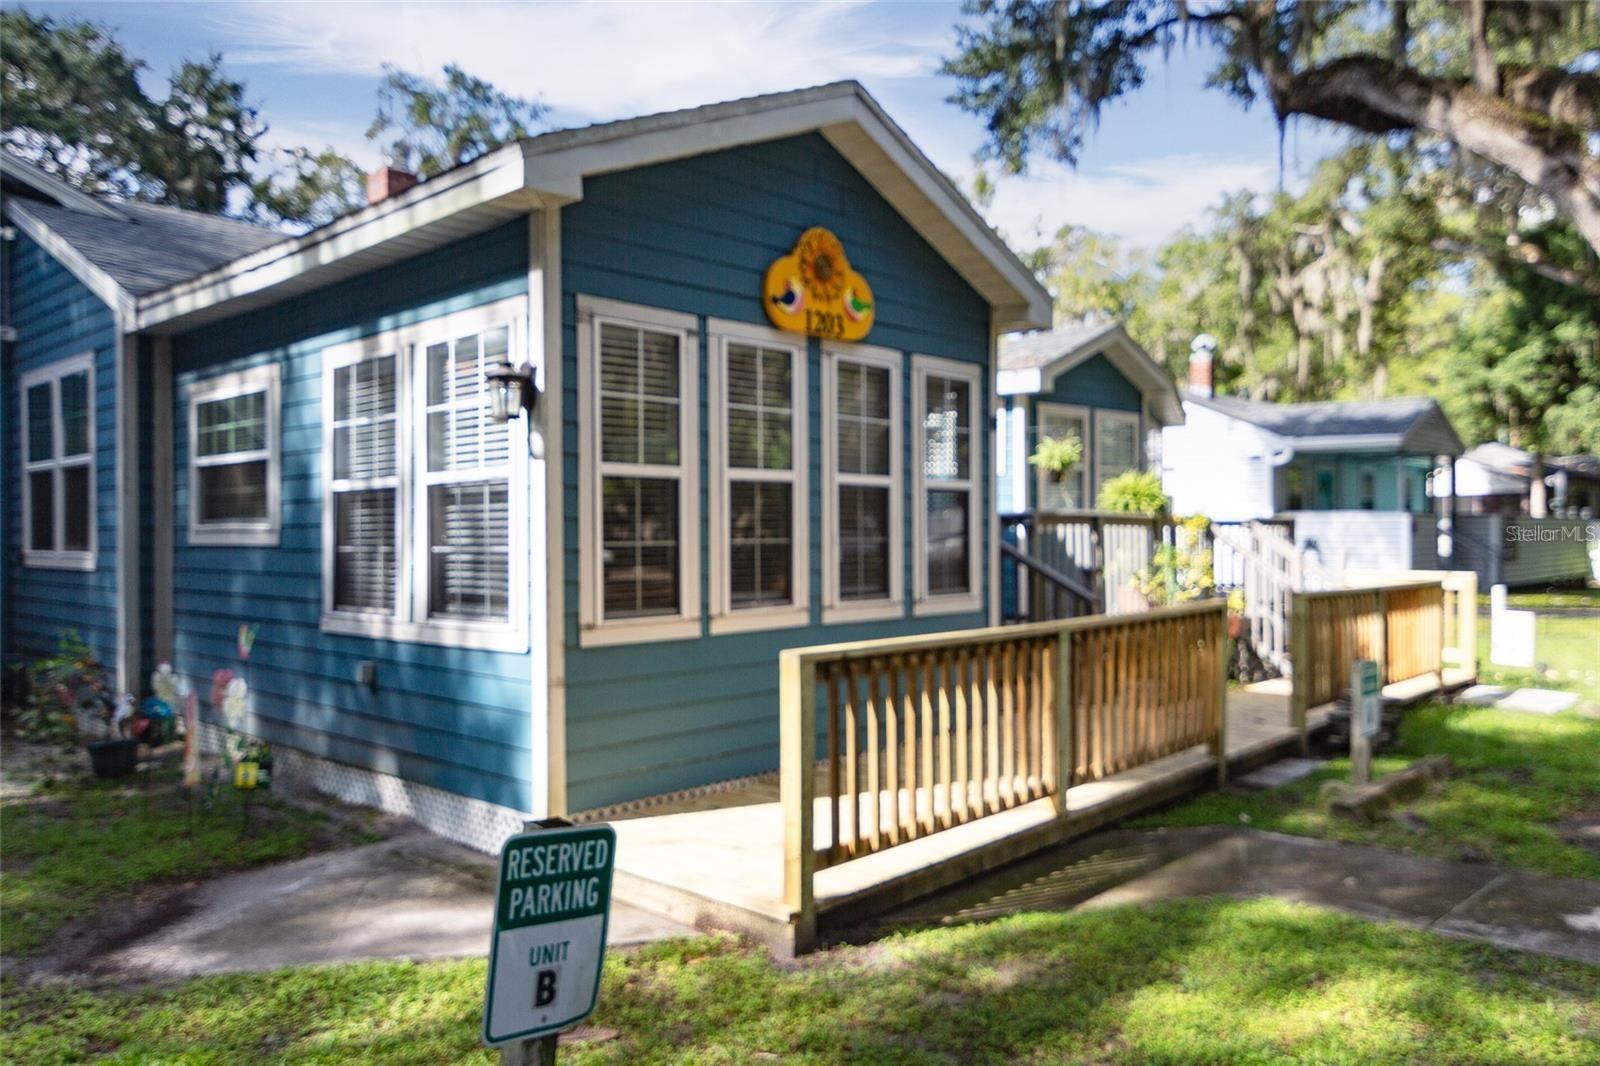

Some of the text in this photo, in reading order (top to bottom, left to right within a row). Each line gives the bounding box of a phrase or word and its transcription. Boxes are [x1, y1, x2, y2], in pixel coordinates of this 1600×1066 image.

[507, 839, 608, 880] RESERVED
[509, 877, 599, 919] PARKING
[530, 941, 570, 966] UNIT
[535, 969, 557, 1007] B
